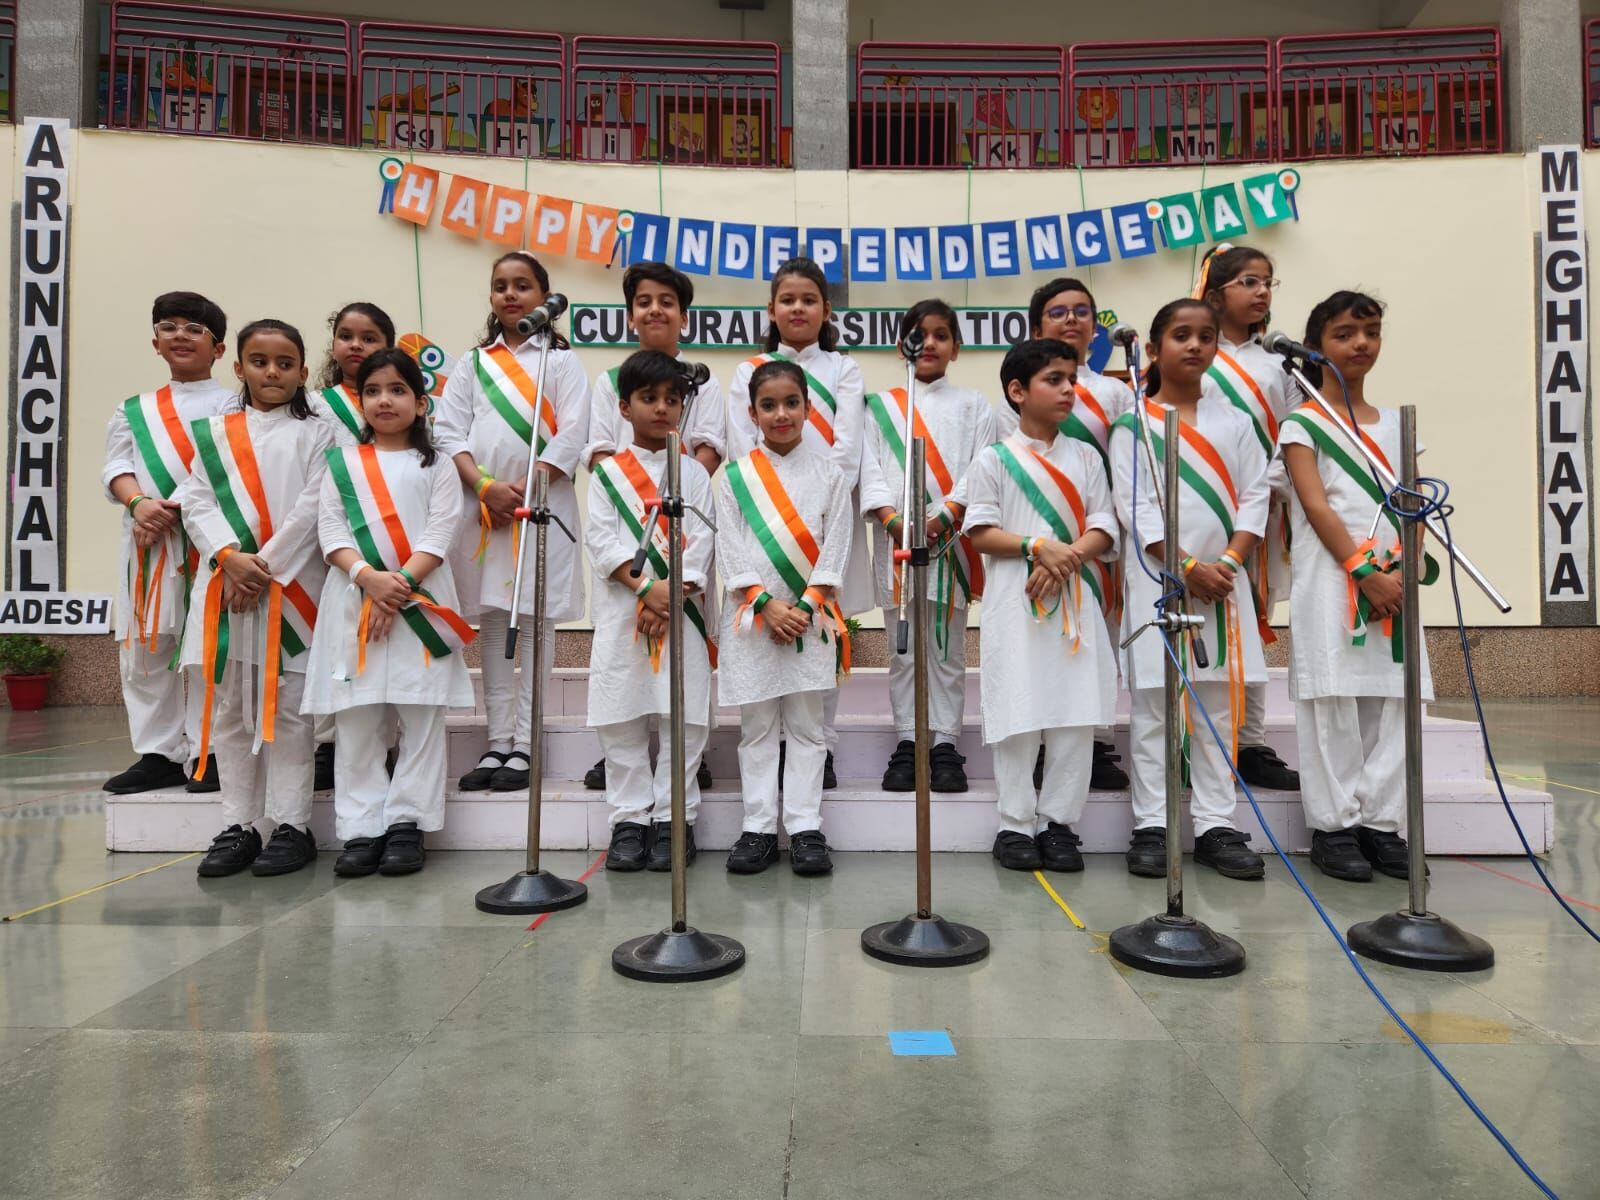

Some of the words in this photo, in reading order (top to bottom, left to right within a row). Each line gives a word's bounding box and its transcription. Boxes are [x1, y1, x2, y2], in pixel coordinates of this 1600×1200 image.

[395, 120, 434, 149] Gg
[496, 127, 530, 151] Hh
[1172, 136, 1215, 157] Mm
[1385, 123, 1419, 145] Nn
[988, 141, 1021, 161] Kk
[400, 172, 613, 254] HAPPY
[642, 213, 1147, 274] INDEPENDENCE
[1166, 183, 1276, 241] DAY
[574, 308, 768, 345] CULURAL
[18, 124, 65, 592] ARUNACHAL
[1541, 151, 1585, 596] MEGHALAYA
